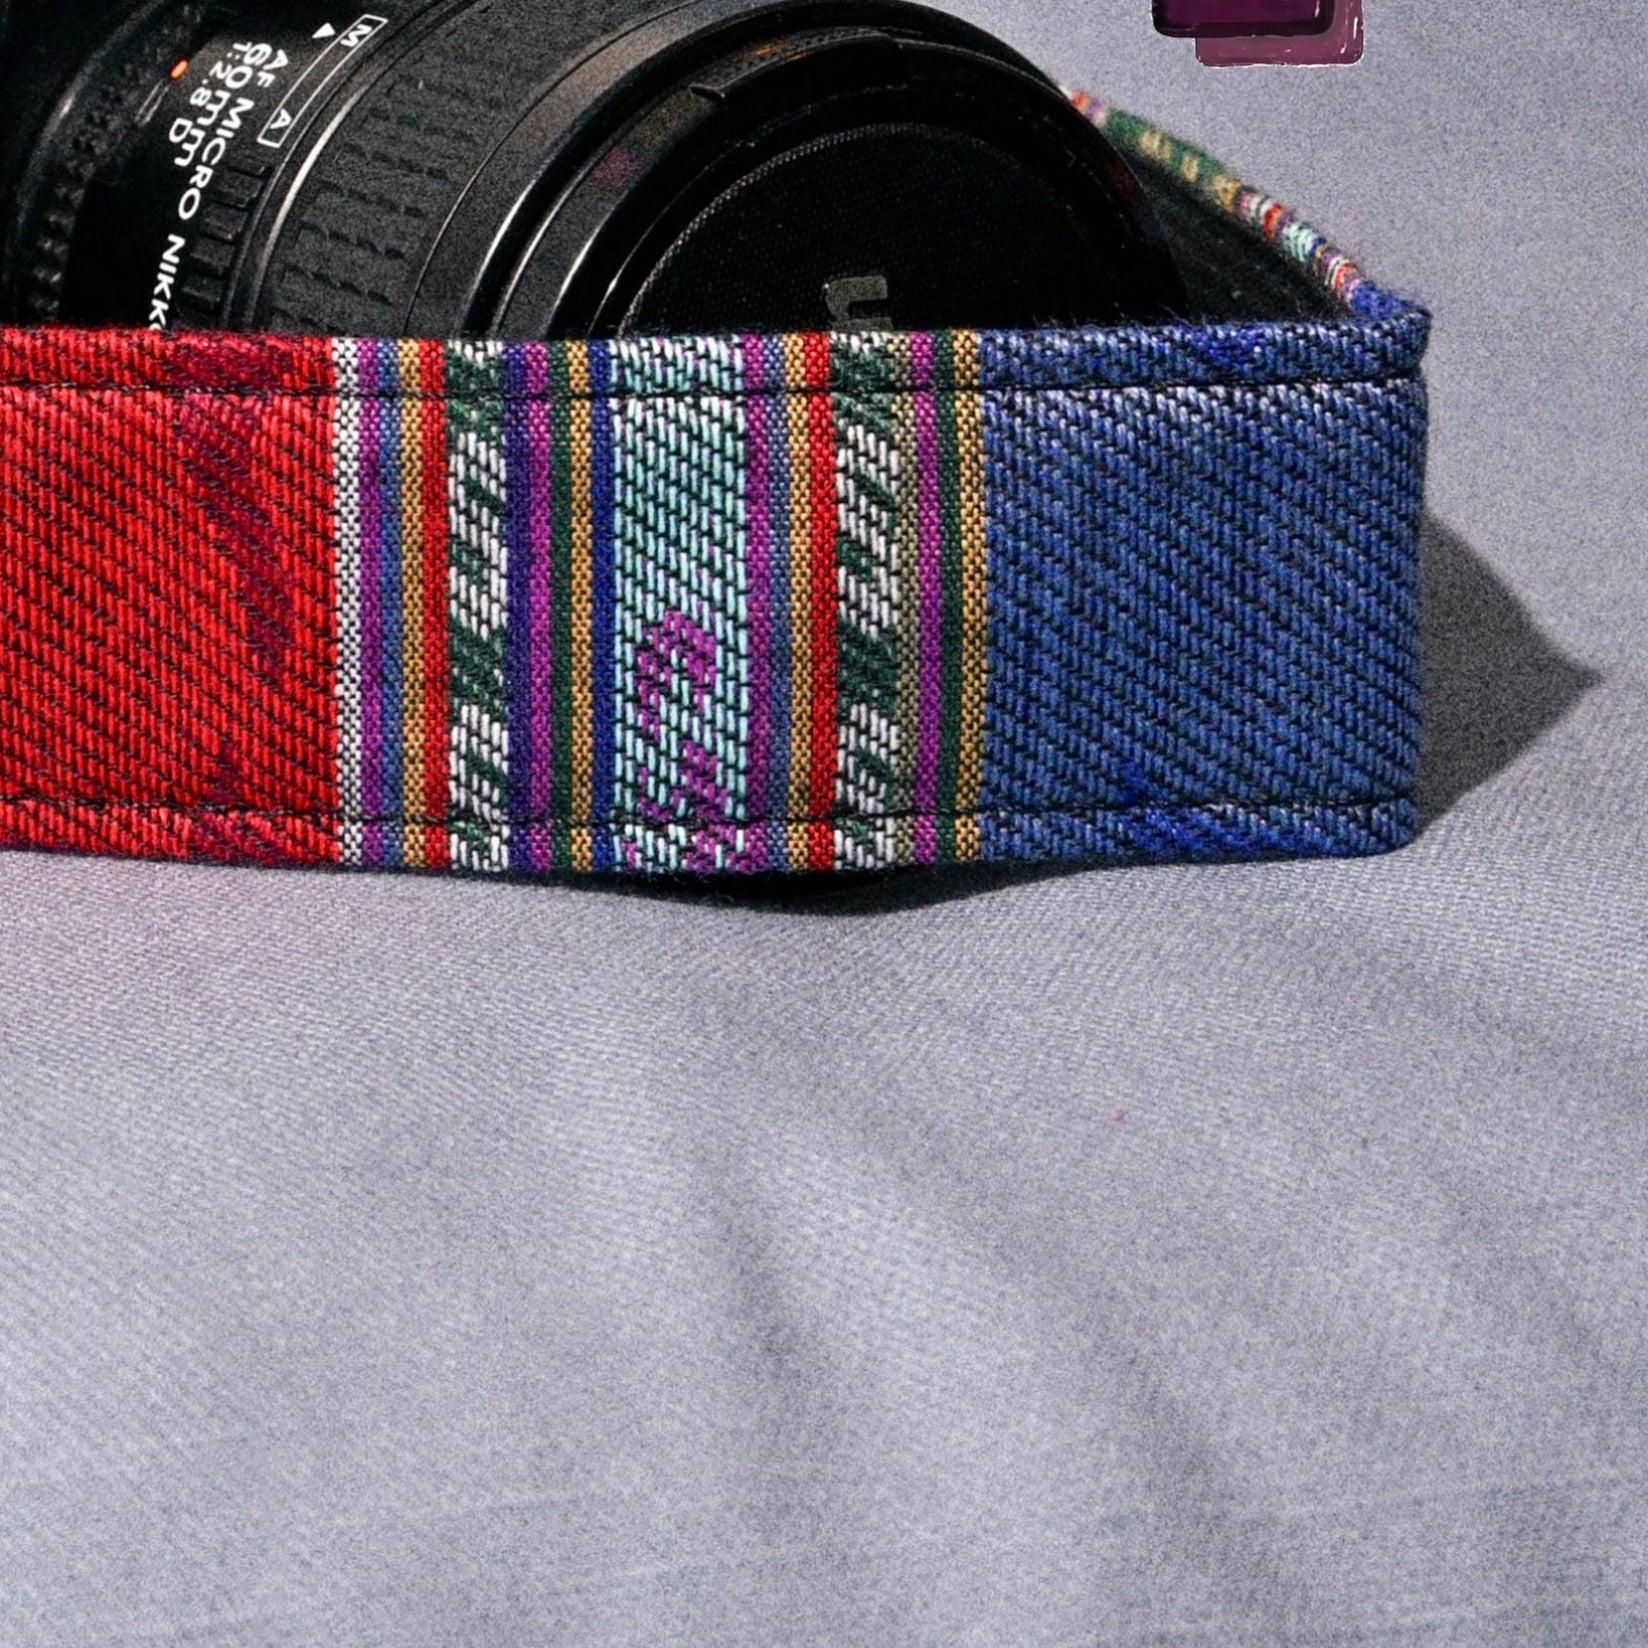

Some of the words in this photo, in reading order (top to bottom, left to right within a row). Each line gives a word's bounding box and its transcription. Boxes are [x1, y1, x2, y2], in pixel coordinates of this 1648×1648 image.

[257, 49, 289, 88] AF
[340, 23, 373, 48] M
[174, 42, 273, 168] 60mm
[270, 108, 293, 131] A
[178, 97, 255, 220] MICRO
[148, 233, 186, 331] NIKK
